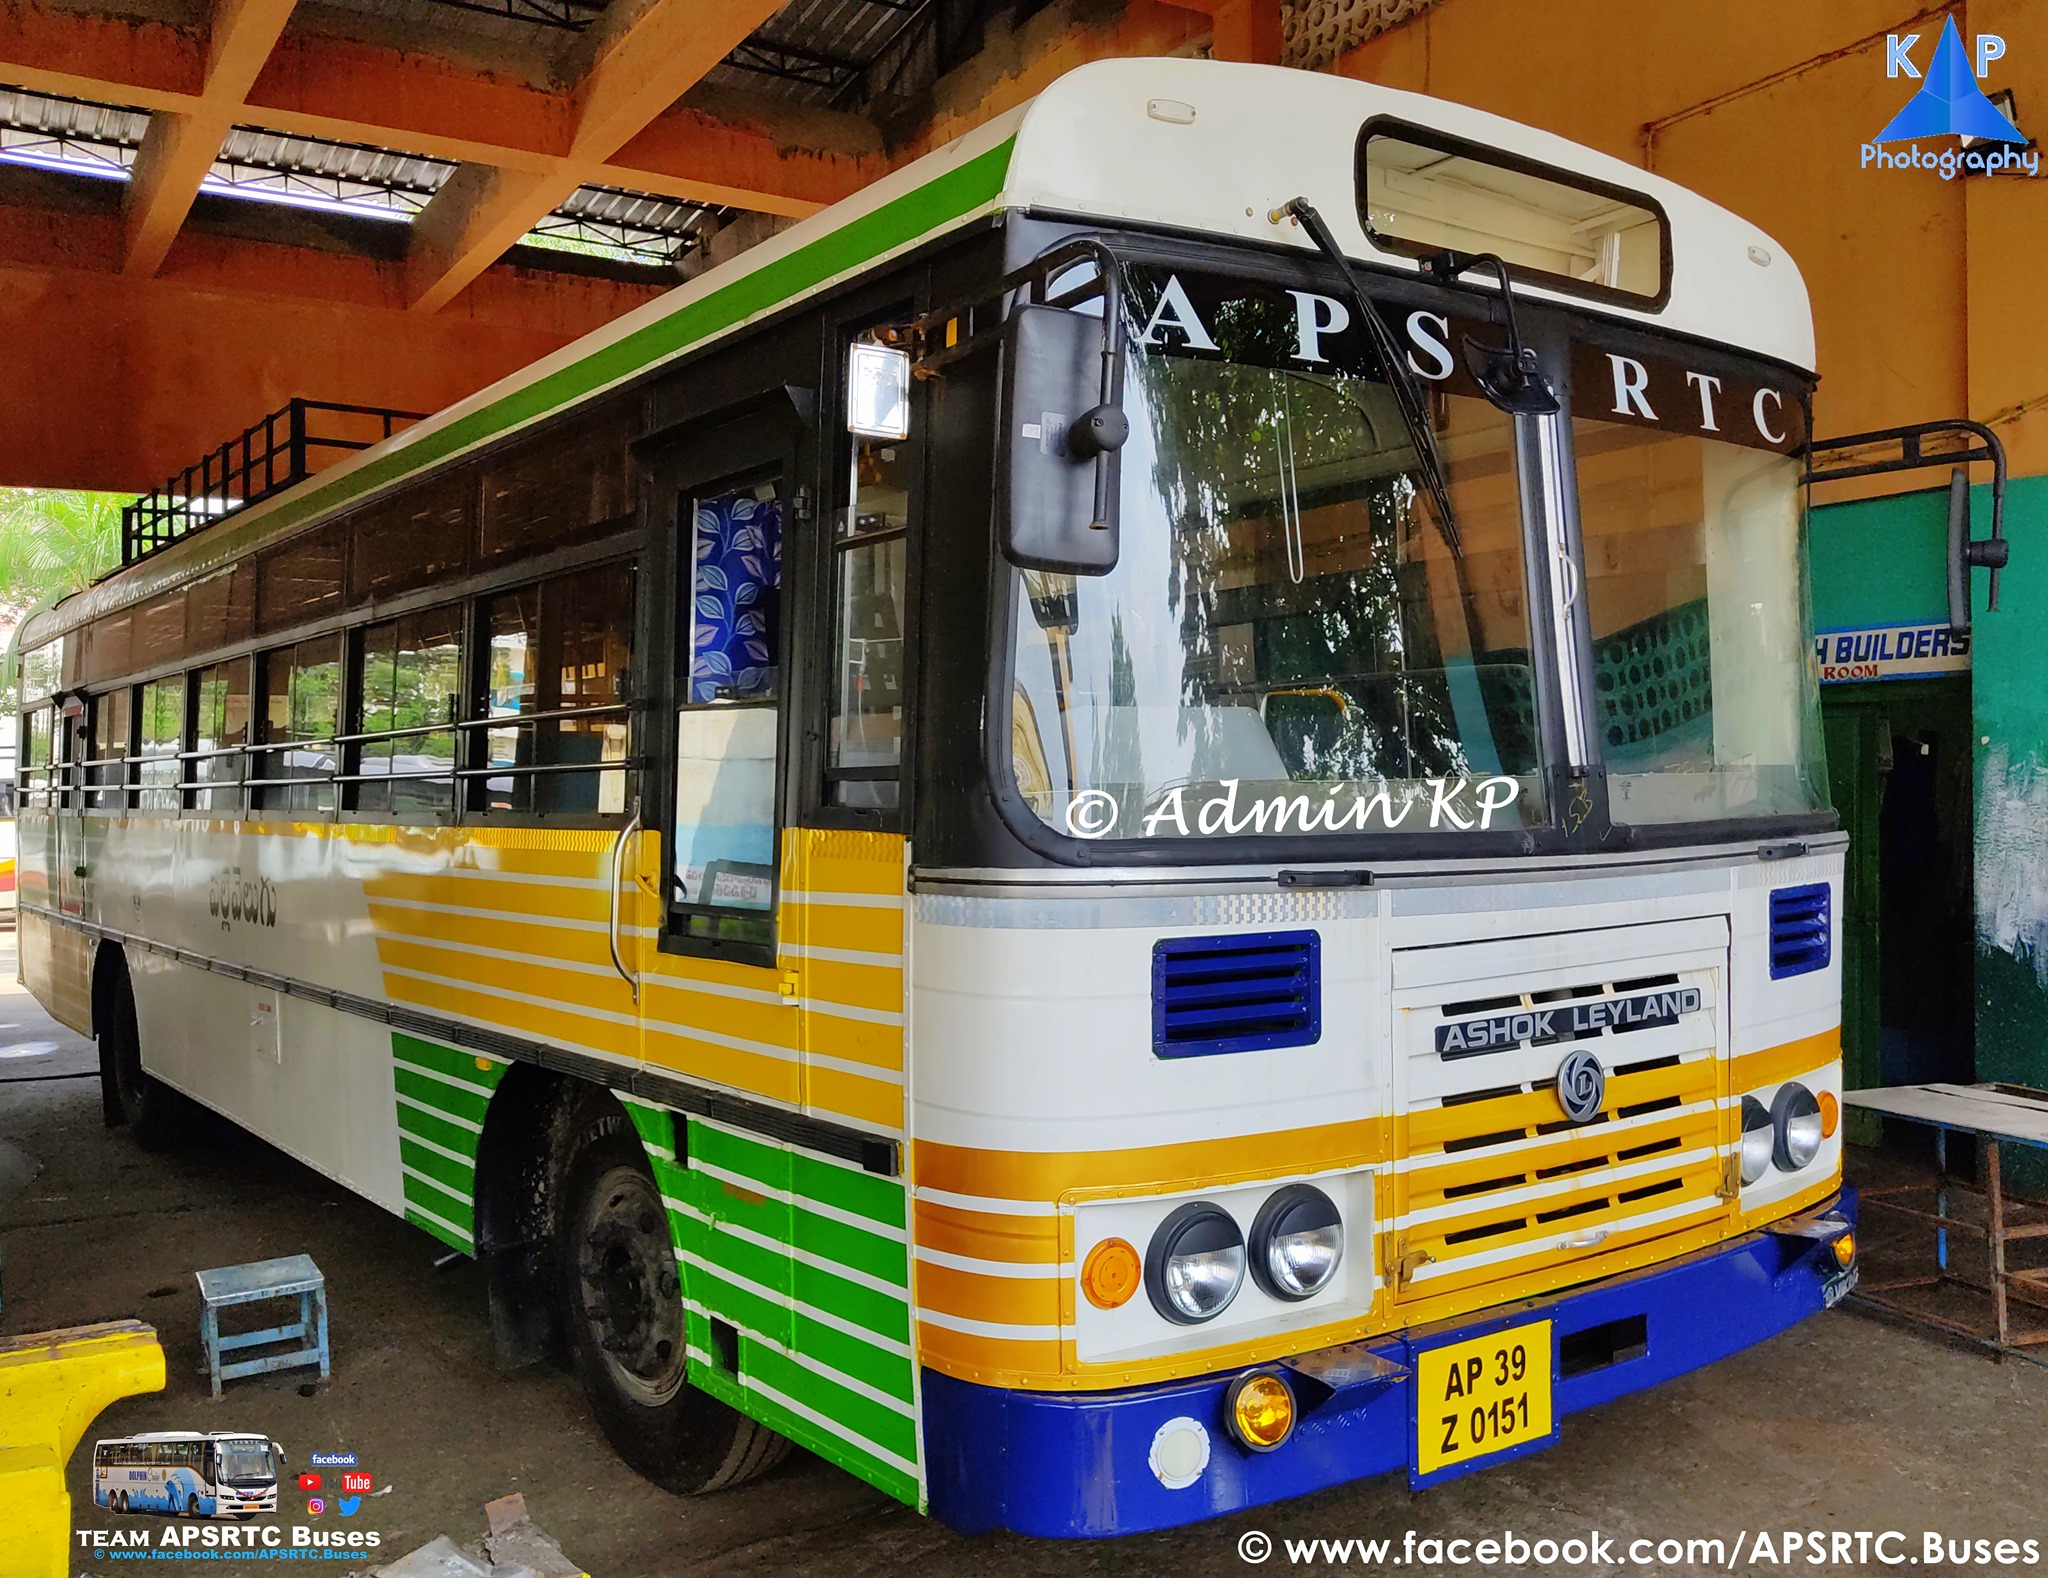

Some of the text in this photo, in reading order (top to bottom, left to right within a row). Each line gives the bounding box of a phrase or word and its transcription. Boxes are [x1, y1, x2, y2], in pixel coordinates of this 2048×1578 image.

[1823, 664, 1878, 680] ROOM
[1835, 626, 1971, 664] BUILDERS
[1442, 989, 1700, 1051] ASHOK LEYLAND
[1444, 1344, 1526, 1402] AP 39
[1441, 1391, 1528, 1454] Z 0151
